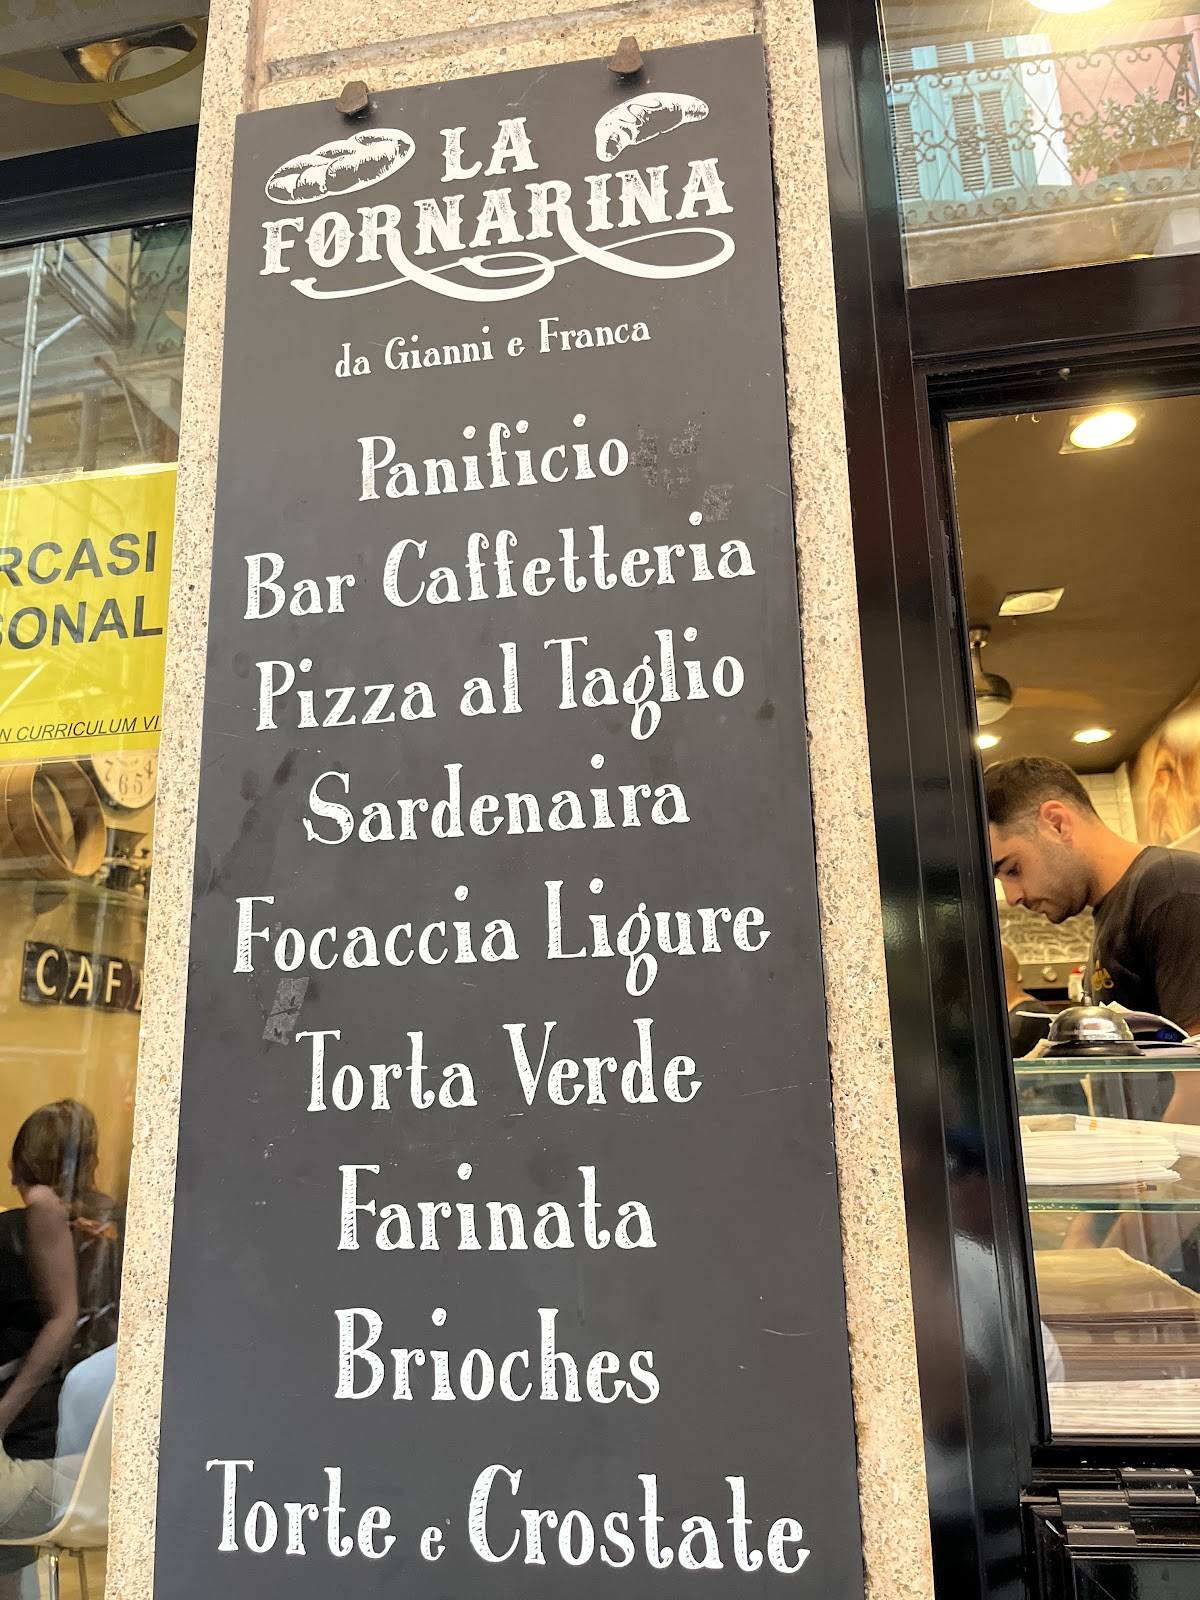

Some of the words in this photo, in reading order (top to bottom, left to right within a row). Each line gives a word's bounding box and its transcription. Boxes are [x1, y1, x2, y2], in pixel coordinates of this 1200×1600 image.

[440, 117, 539, 184] LA
[259, 158, 736, 303] FORNARINA
[335, 343, 371, 378] da
[384, 326, 495, 371] Gianni
[508, 337, 525, 357] e
[538, 317, 652, 354] Franca
[357, 414, 629, 502] Panificio
[0, 531, 157, 587] RCASI
[244, 553, 355, 620] Bar
[383, 511, 755, 608] Caffetteria
[0, 595, 163, 650] ONAL
[17, 717, 137, 741] CURRICULUM
[144, 715, 160, 730] VI
[256, 658, 437, 732] Pizza
[460, 642, 523, 717] al
[543, 627, 745, 741] Taglio
[119, 774, 128, 795] 6
[303, 754, 691, 845] Sardenaira
[233, 886, 520, 974] Focaccia
[545, 878, 771, 997] Ligure
[295, 1029, 478, 1112] Torta
[502, 1018, 703, 1106] Verde
[337, 1163, 657, 1251] Farinata
[335, 1308, 660, 1404] Brioches
[205, 1458, 397, 1559] Torte
[420, 1526, 446, 1561] e
[468, 1464, 811, 1574] Crostate
